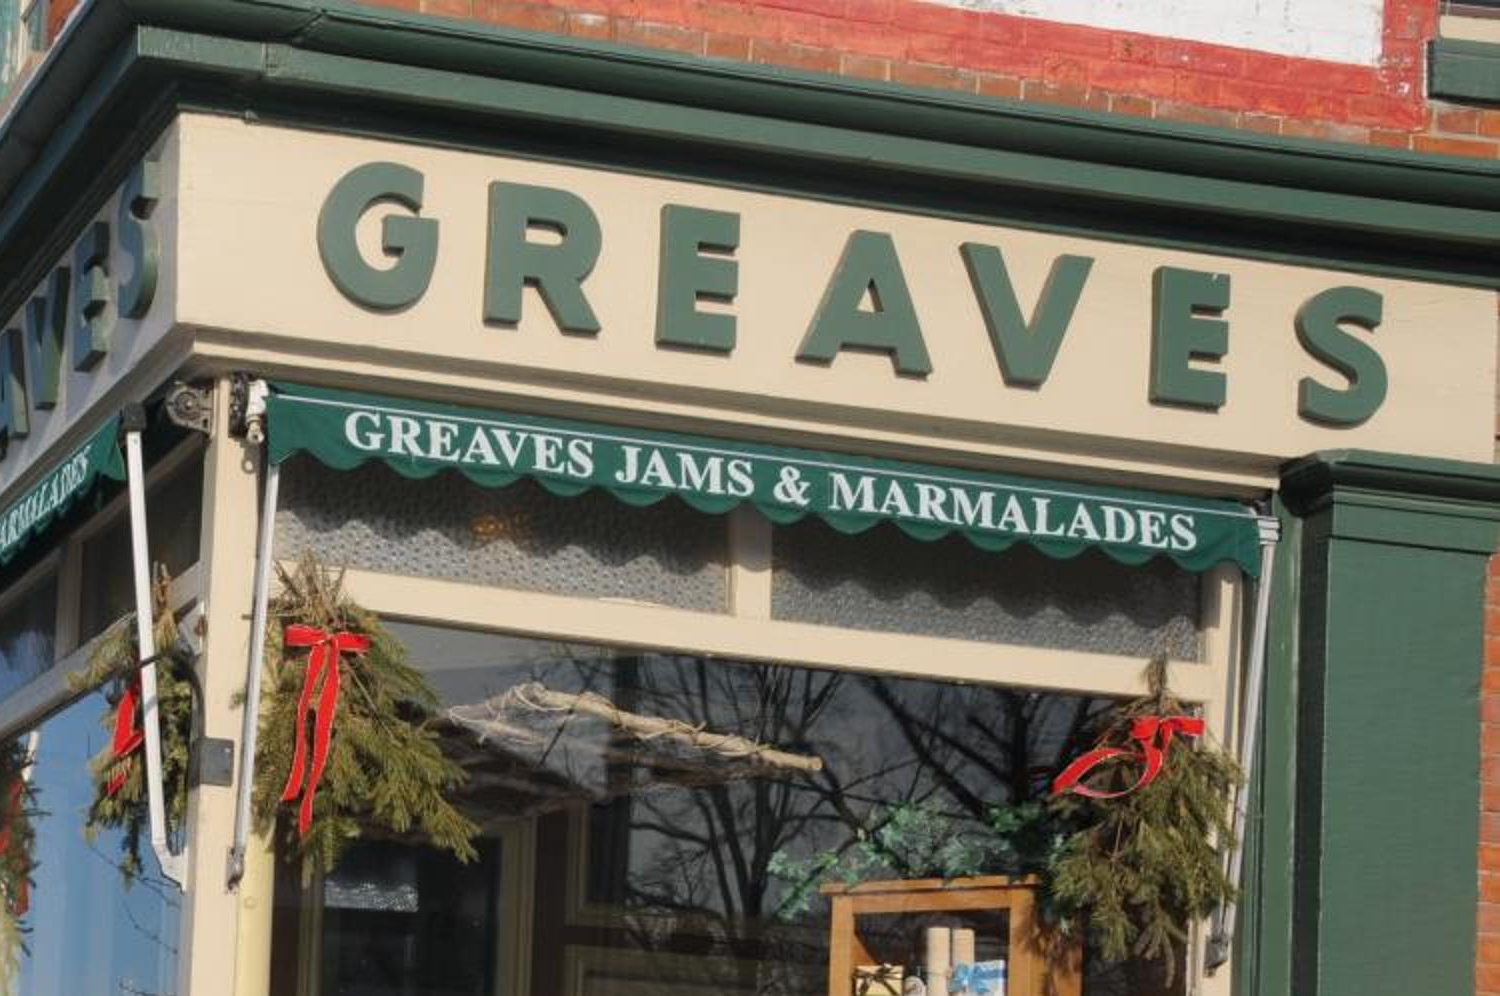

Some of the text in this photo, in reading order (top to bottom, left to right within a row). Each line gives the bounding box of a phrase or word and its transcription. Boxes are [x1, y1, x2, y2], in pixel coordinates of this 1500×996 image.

[316, 161, 1388, 428] GREAVES
[344, 409, 1198, 553] GREAVES JAMS & MARMALADES
